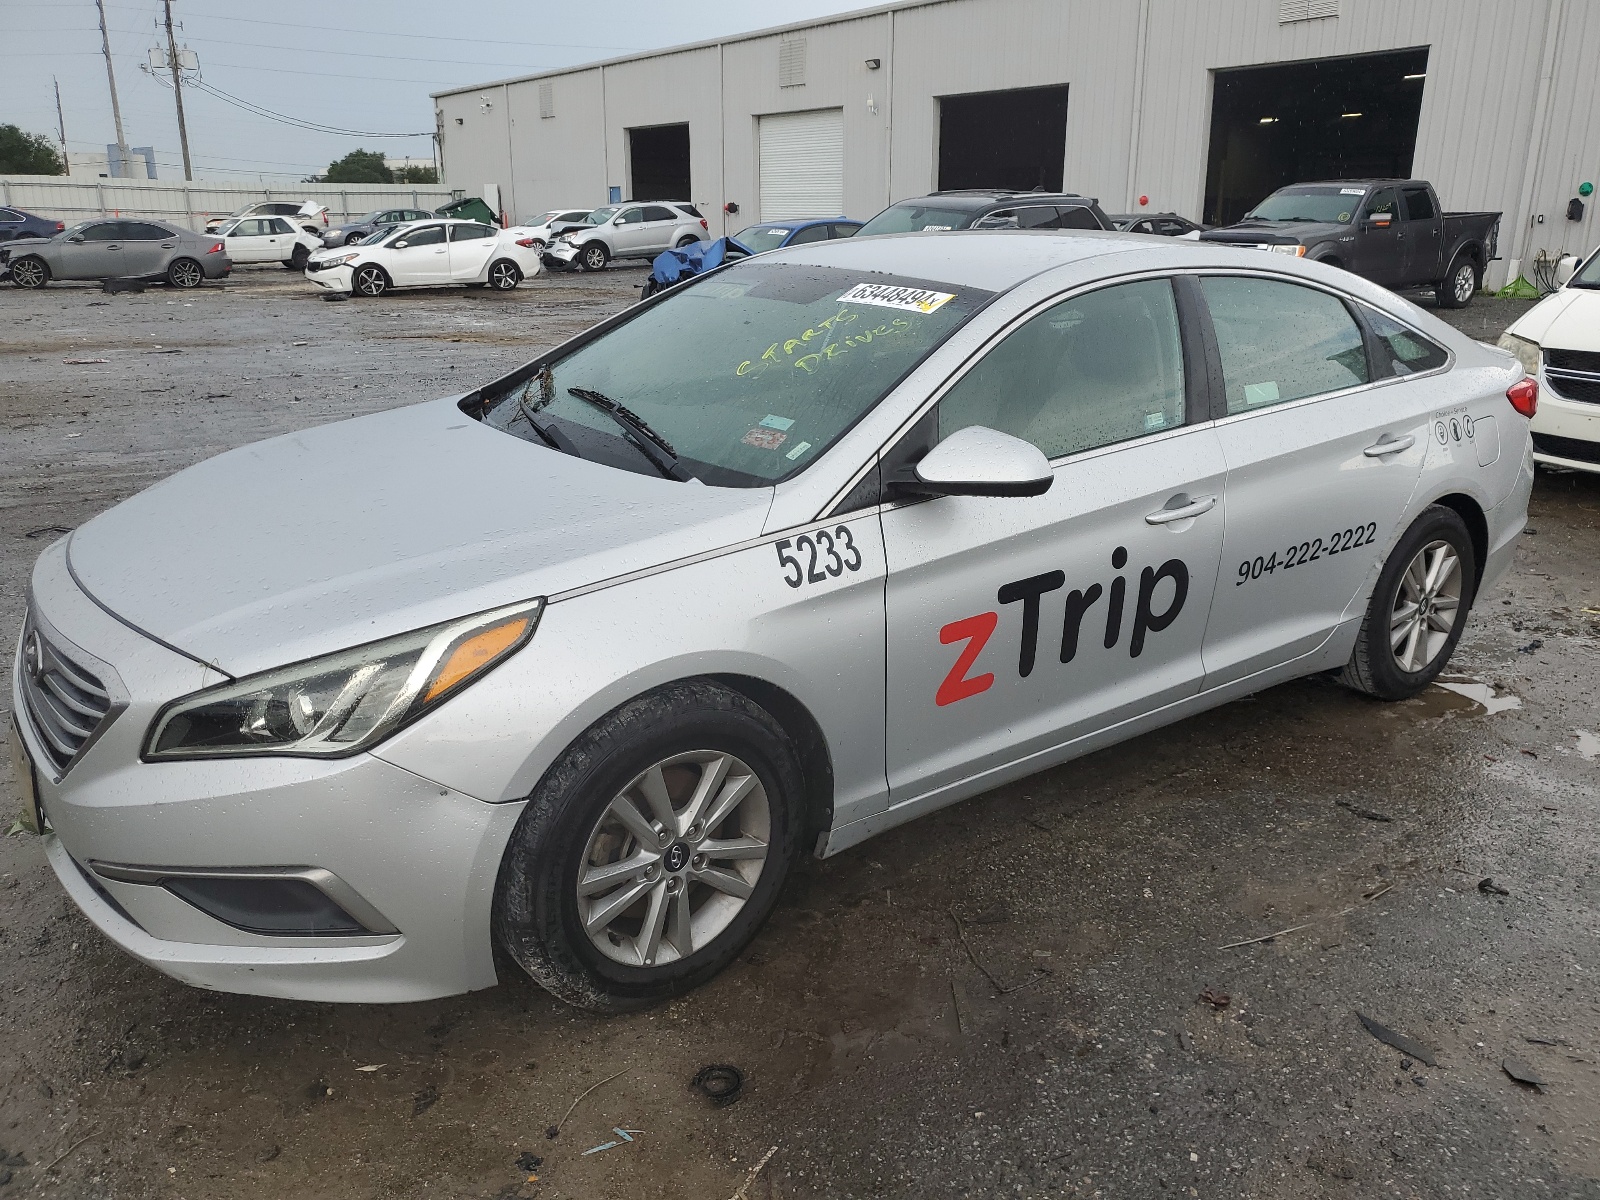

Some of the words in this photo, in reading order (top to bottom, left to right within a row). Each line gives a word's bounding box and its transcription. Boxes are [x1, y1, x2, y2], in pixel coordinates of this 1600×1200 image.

[775, 525, 862, 588] 5233
[1236, 521, 1377, 586] 904-222-2222
[935, 546, 1189, 706] zTrip
